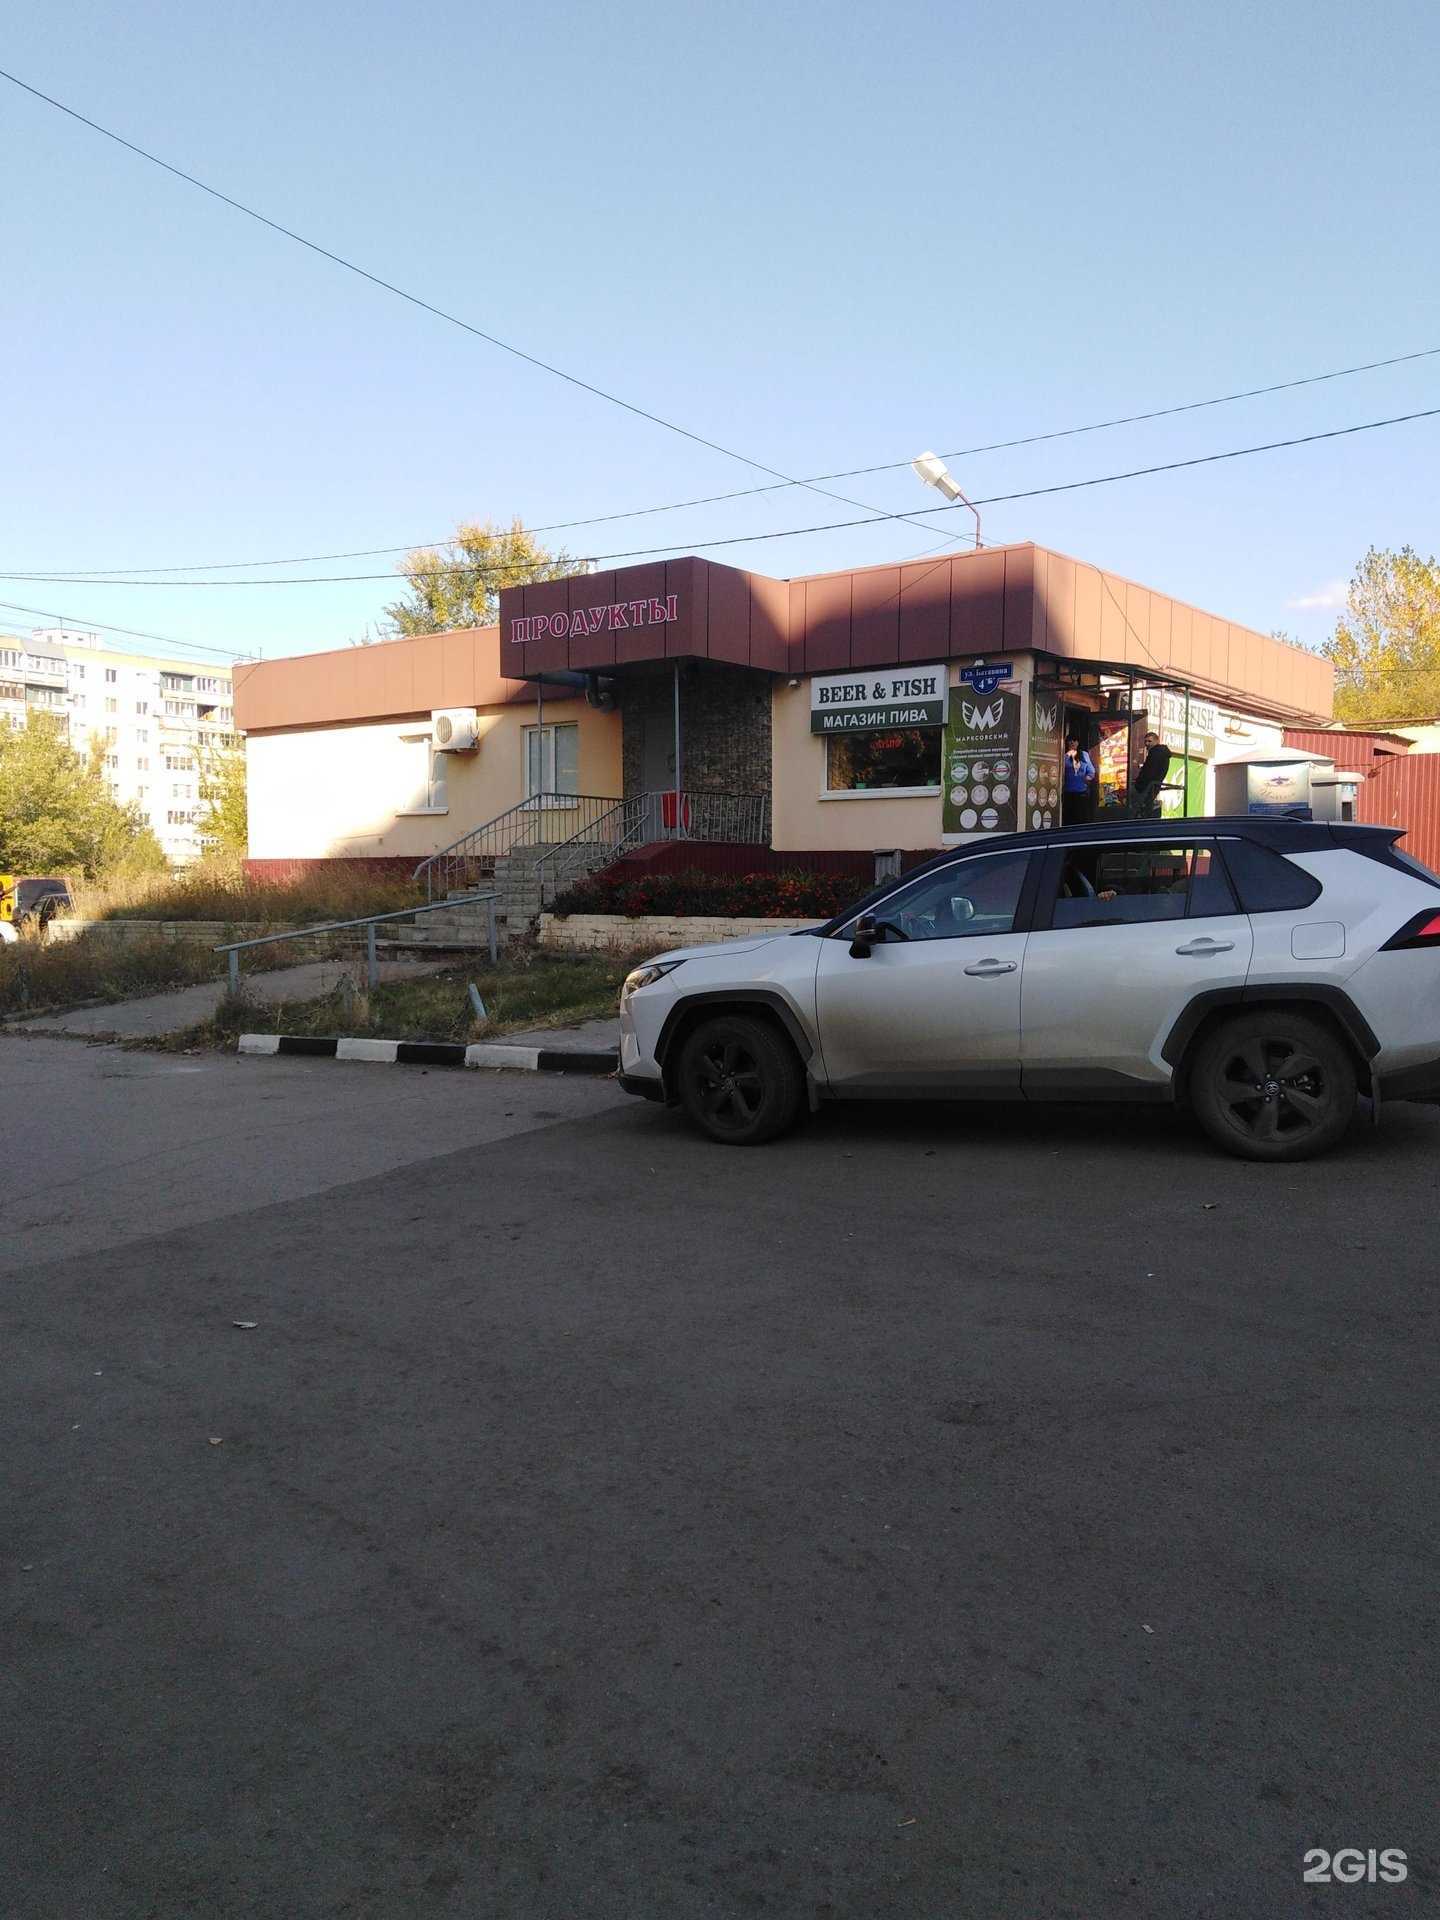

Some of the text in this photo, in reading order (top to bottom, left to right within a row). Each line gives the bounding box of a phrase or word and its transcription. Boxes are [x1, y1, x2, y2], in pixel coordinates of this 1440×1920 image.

[511, 595, 677, 643] ПРОДУКТЫ
[818, 677, 937, 704] BEER & FISH
[823, 709, 928, 729] МАГАЗИН ПИВА
[1189, 705, 1214, 730] FISH
